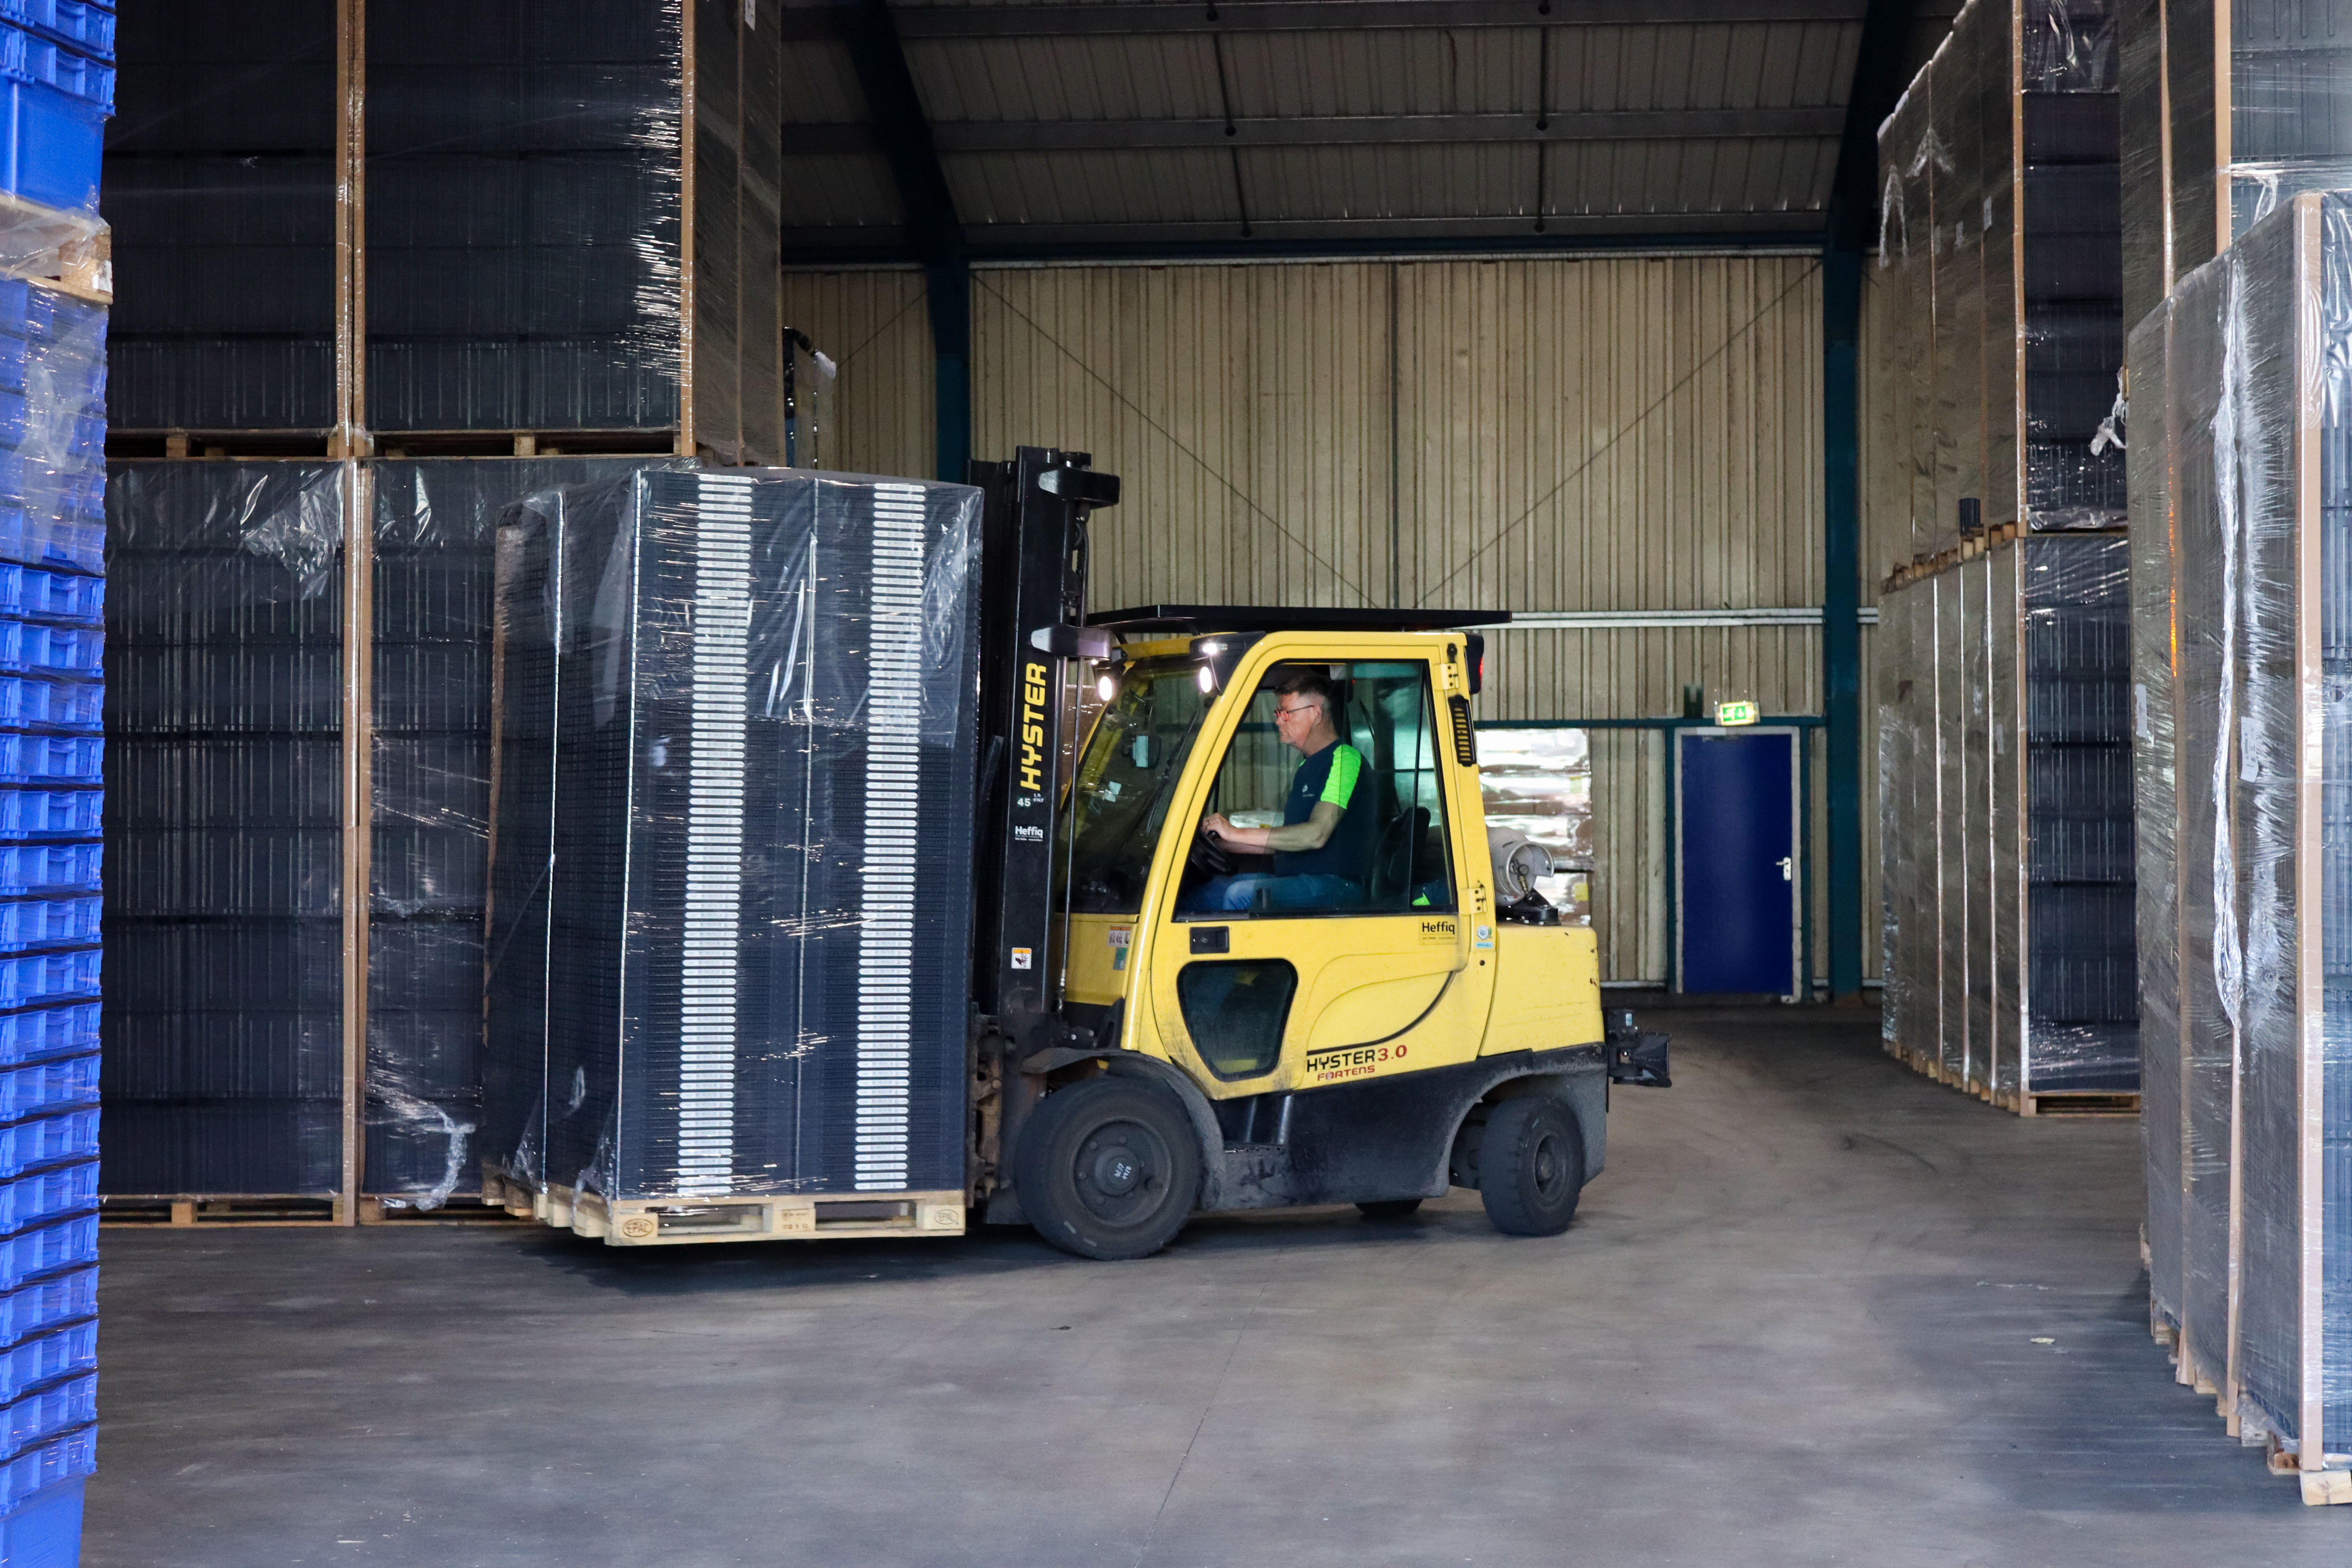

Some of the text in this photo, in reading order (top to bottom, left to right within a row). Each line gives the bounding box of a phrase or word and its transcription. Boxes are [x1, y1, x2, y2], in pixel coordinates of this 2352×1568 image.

[1020, 663, 1047, 791] HYSTER
[1017, 797, 1031, 807] 45
[1014, 826, 1044, 838] Heffiq
[1422, 921, 1455, 935] Heffiq
[1307, 1045, 1407, 1073] HYSTER 3.0
[1317, 1065, 1375, 1081] FORTENS
